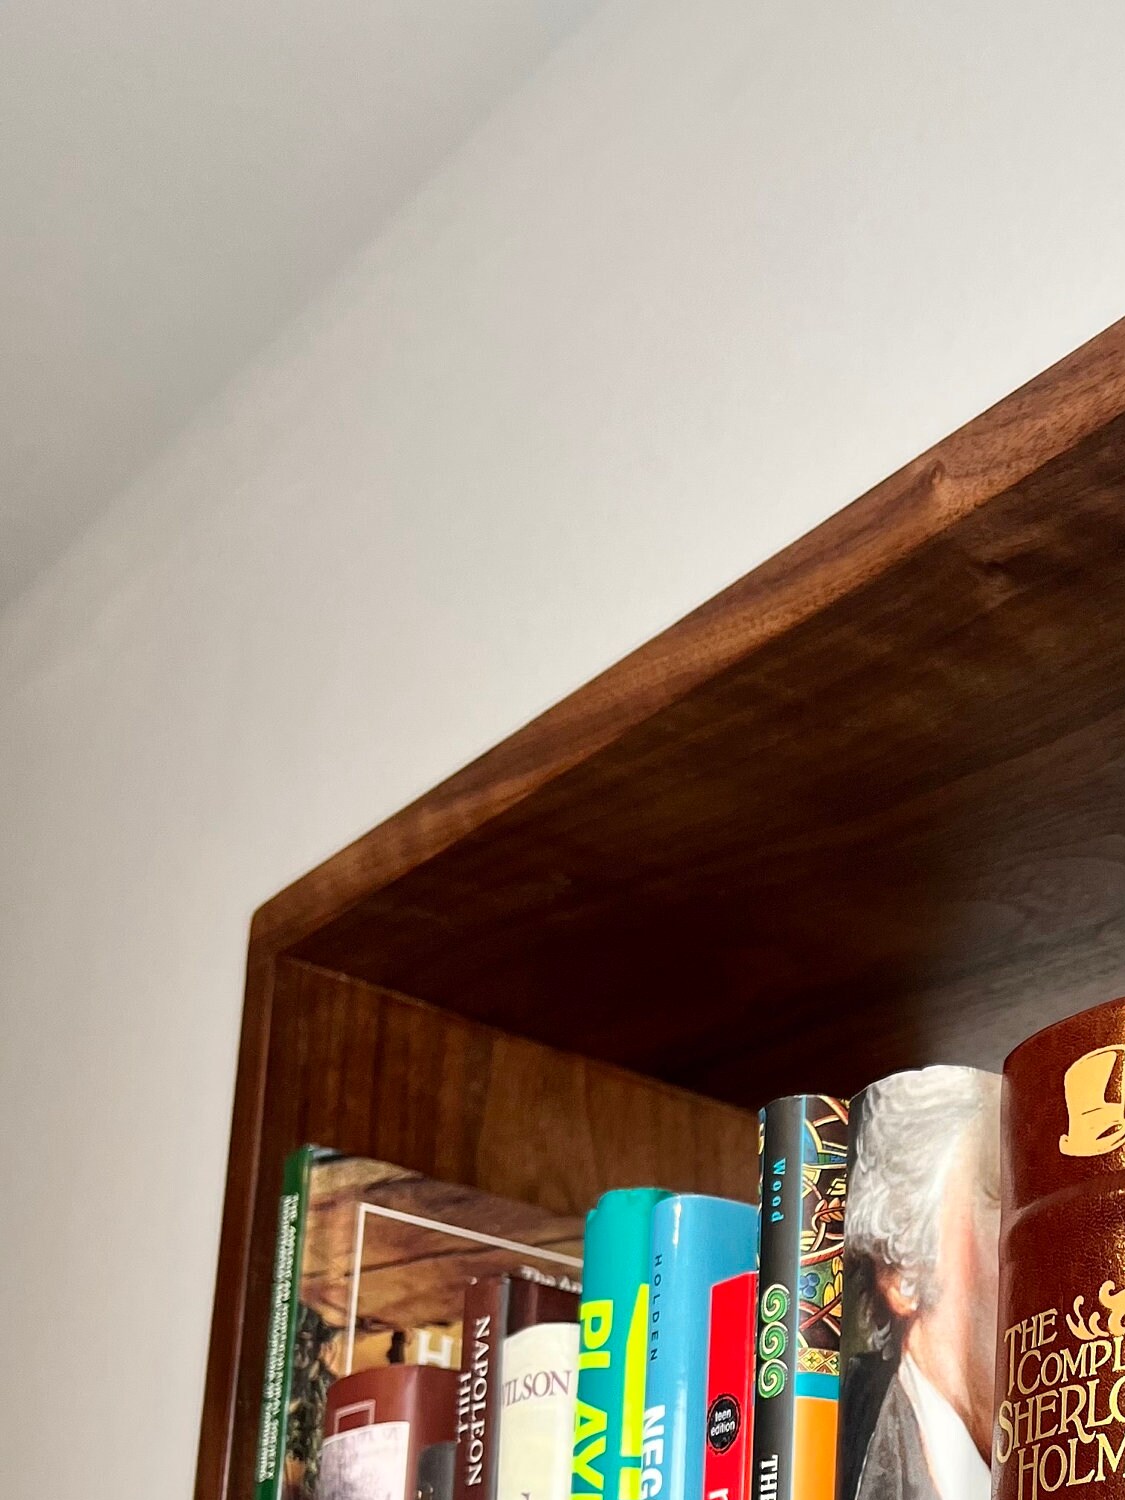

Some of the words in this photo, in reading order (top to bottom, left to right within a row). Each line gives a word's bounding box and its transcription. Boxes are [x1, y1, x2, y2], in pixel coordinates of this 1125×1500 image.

[769, 1158, 787, 1223] Wood
[650, 1254, 663, 1363] HOLDEN
[503, 1369, 573, 1407] ILSON
[1004, 1310, 1058, 1396] THE
[457, 1367, 473, 1444] HILL
[464, 1314, 491, 1487] NAPOLEON
[711, 1421, 736, 1437] edition
